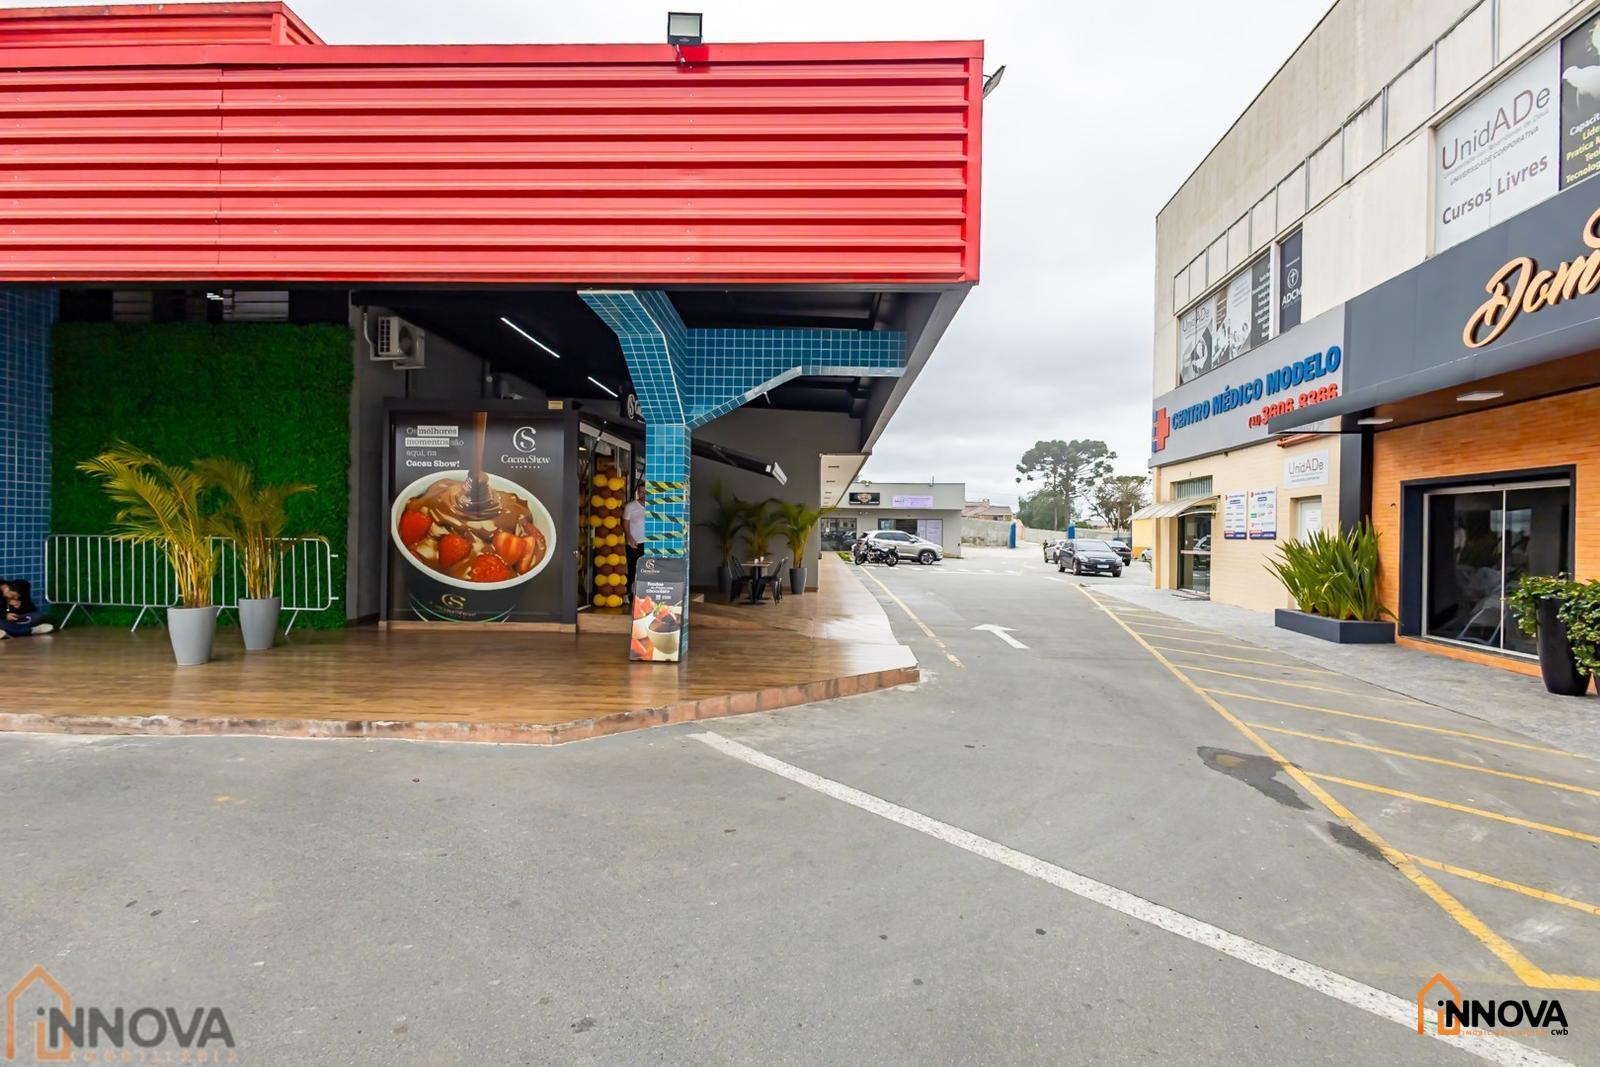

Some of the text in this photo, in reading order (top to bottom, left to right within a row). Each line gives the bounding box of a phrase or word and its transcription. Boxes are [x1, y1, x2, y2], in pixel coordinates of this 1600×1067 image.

[1442, 87, 1550, 170] UnidADe
[1442, 155, 1548, 225] Cursos Livres
[1171, 345, 1341, 431] CENTRO MÉDICO MODELO
[418, 427, 457, 436] melhores
[406, 439, 449, 447] momentos
[406, 459, 460, 468] Cacau Show!
[1288, 457, 1324, 475] UnidADe
